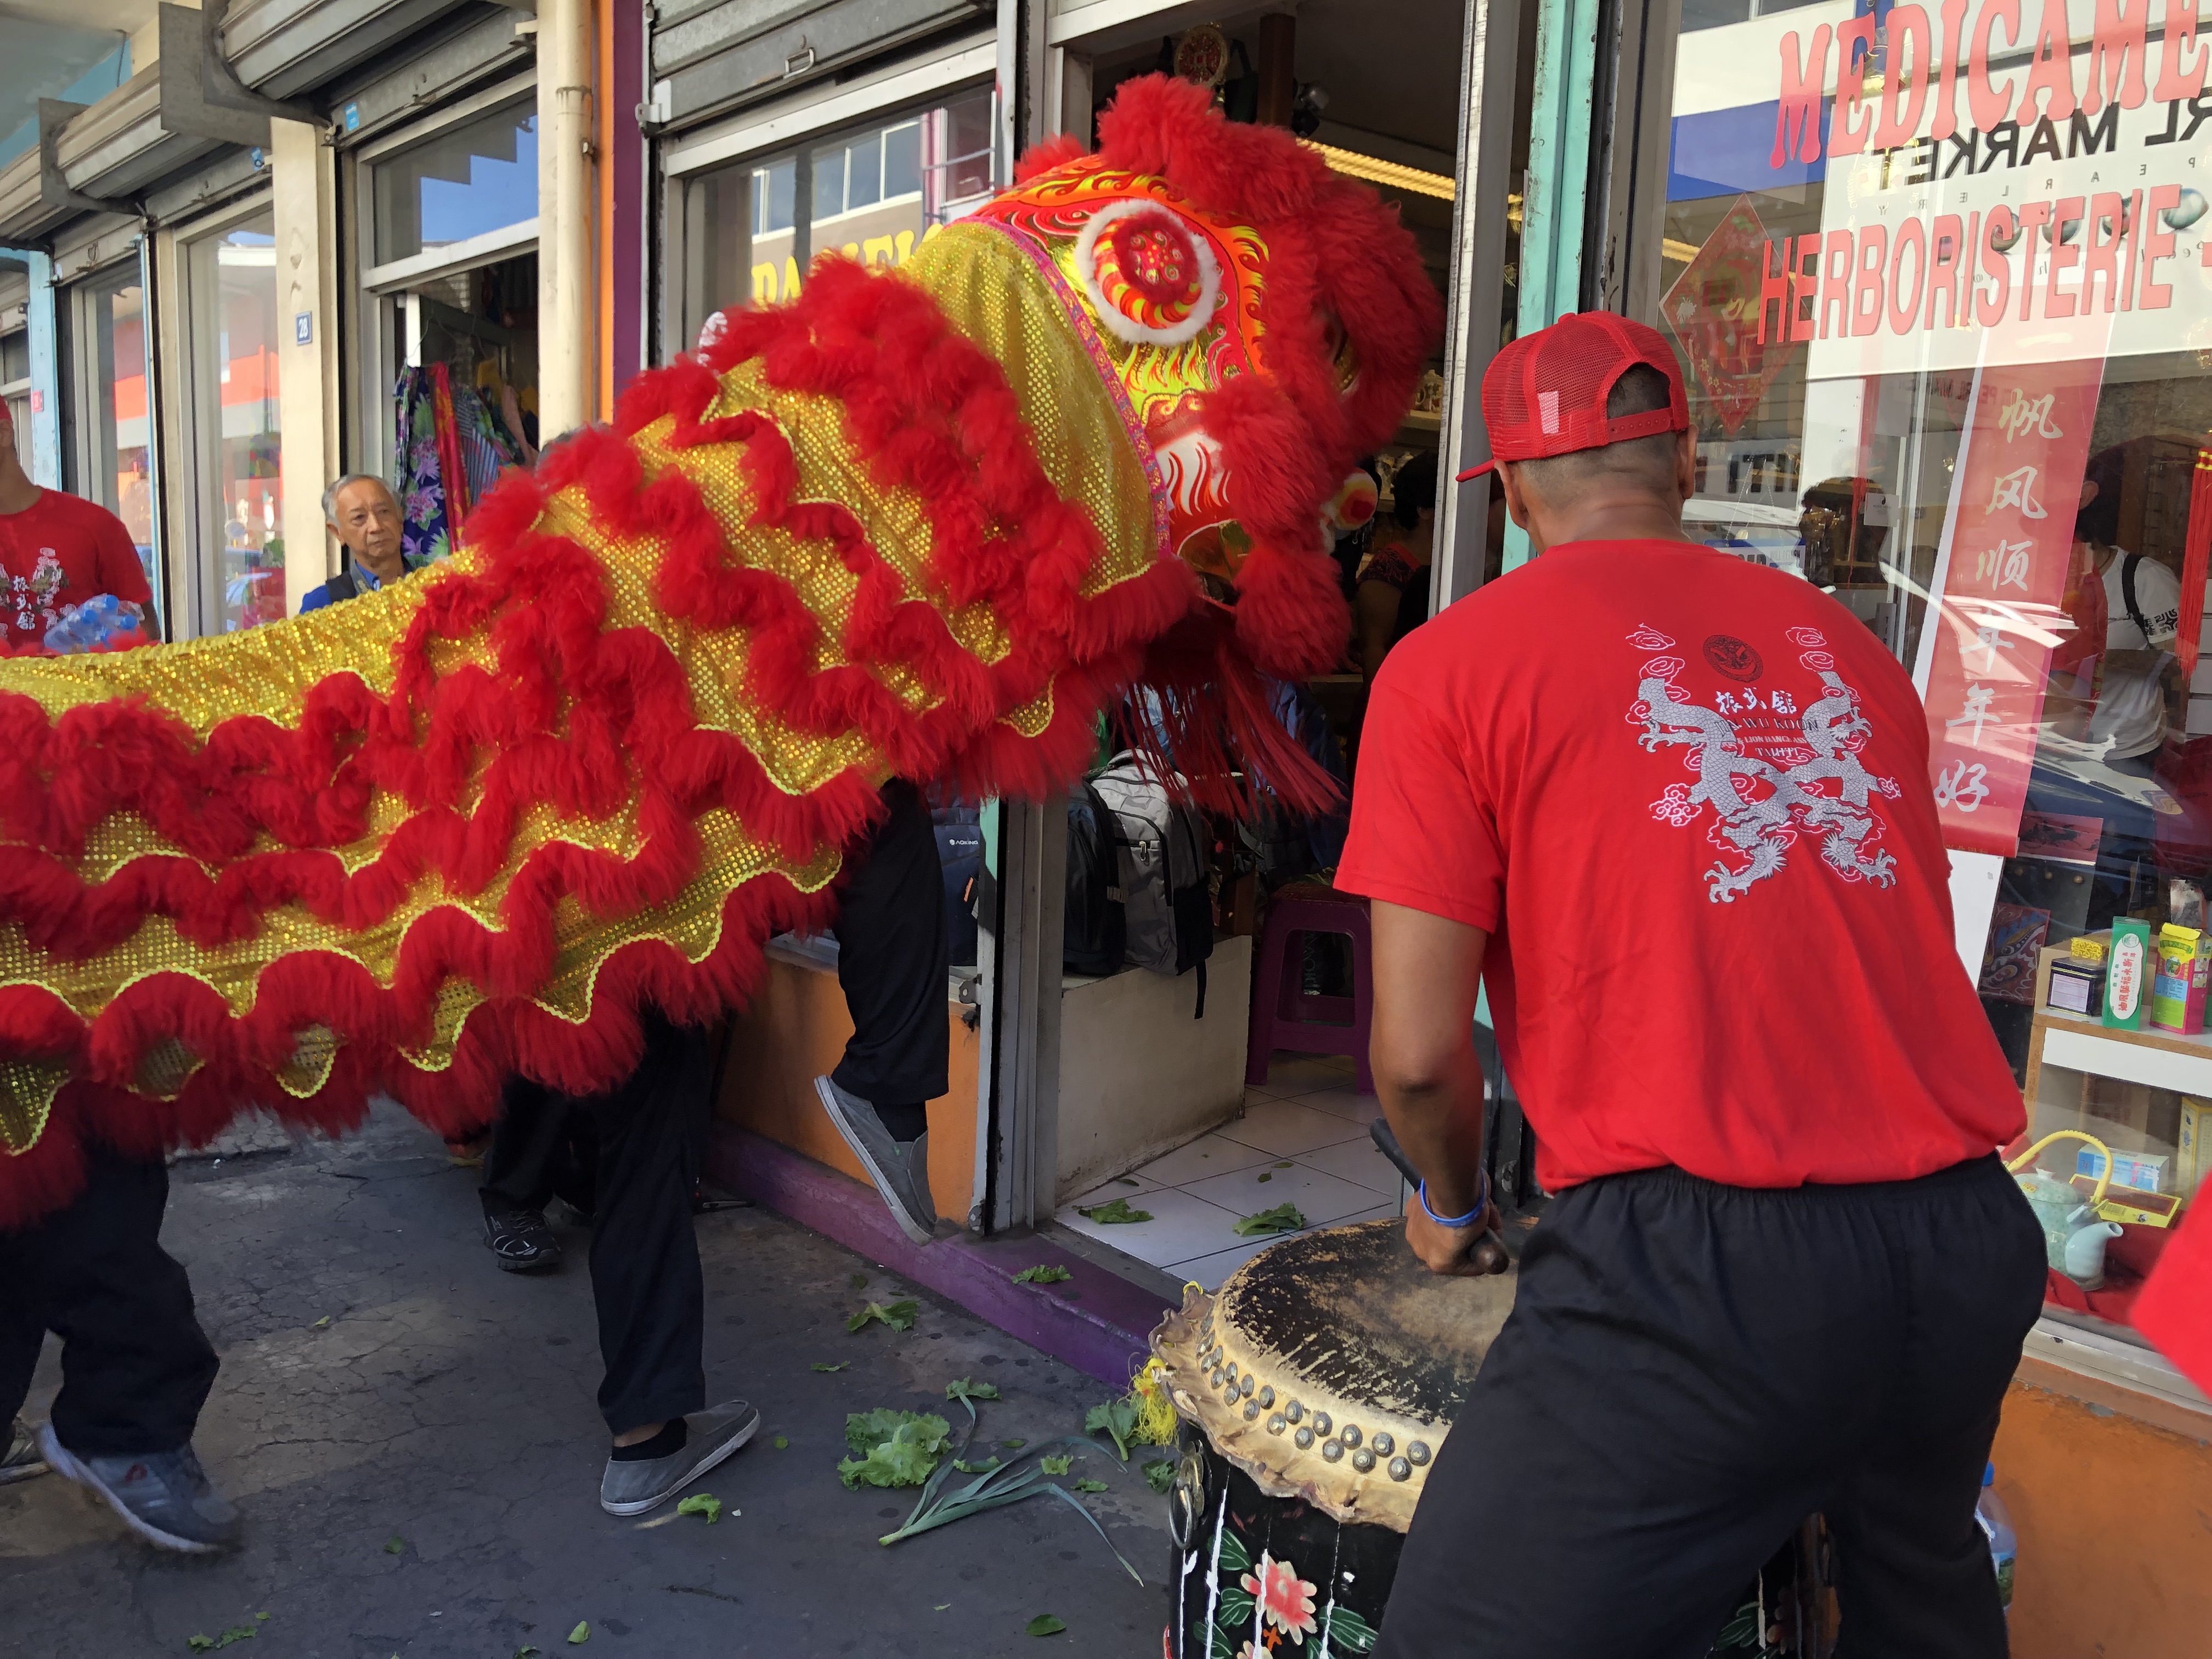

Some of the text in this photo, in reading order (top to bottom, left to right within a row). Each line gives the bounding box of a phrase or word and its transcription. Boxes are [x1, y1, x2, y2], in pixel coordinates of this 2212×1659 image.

[1757, 184, 2181, 345] HERBORISTERIE
[1742, 718, 1769, 729] WU
[1773, 718, 1819, 731] KOON
[1745, 735, 1764, 743] LION
